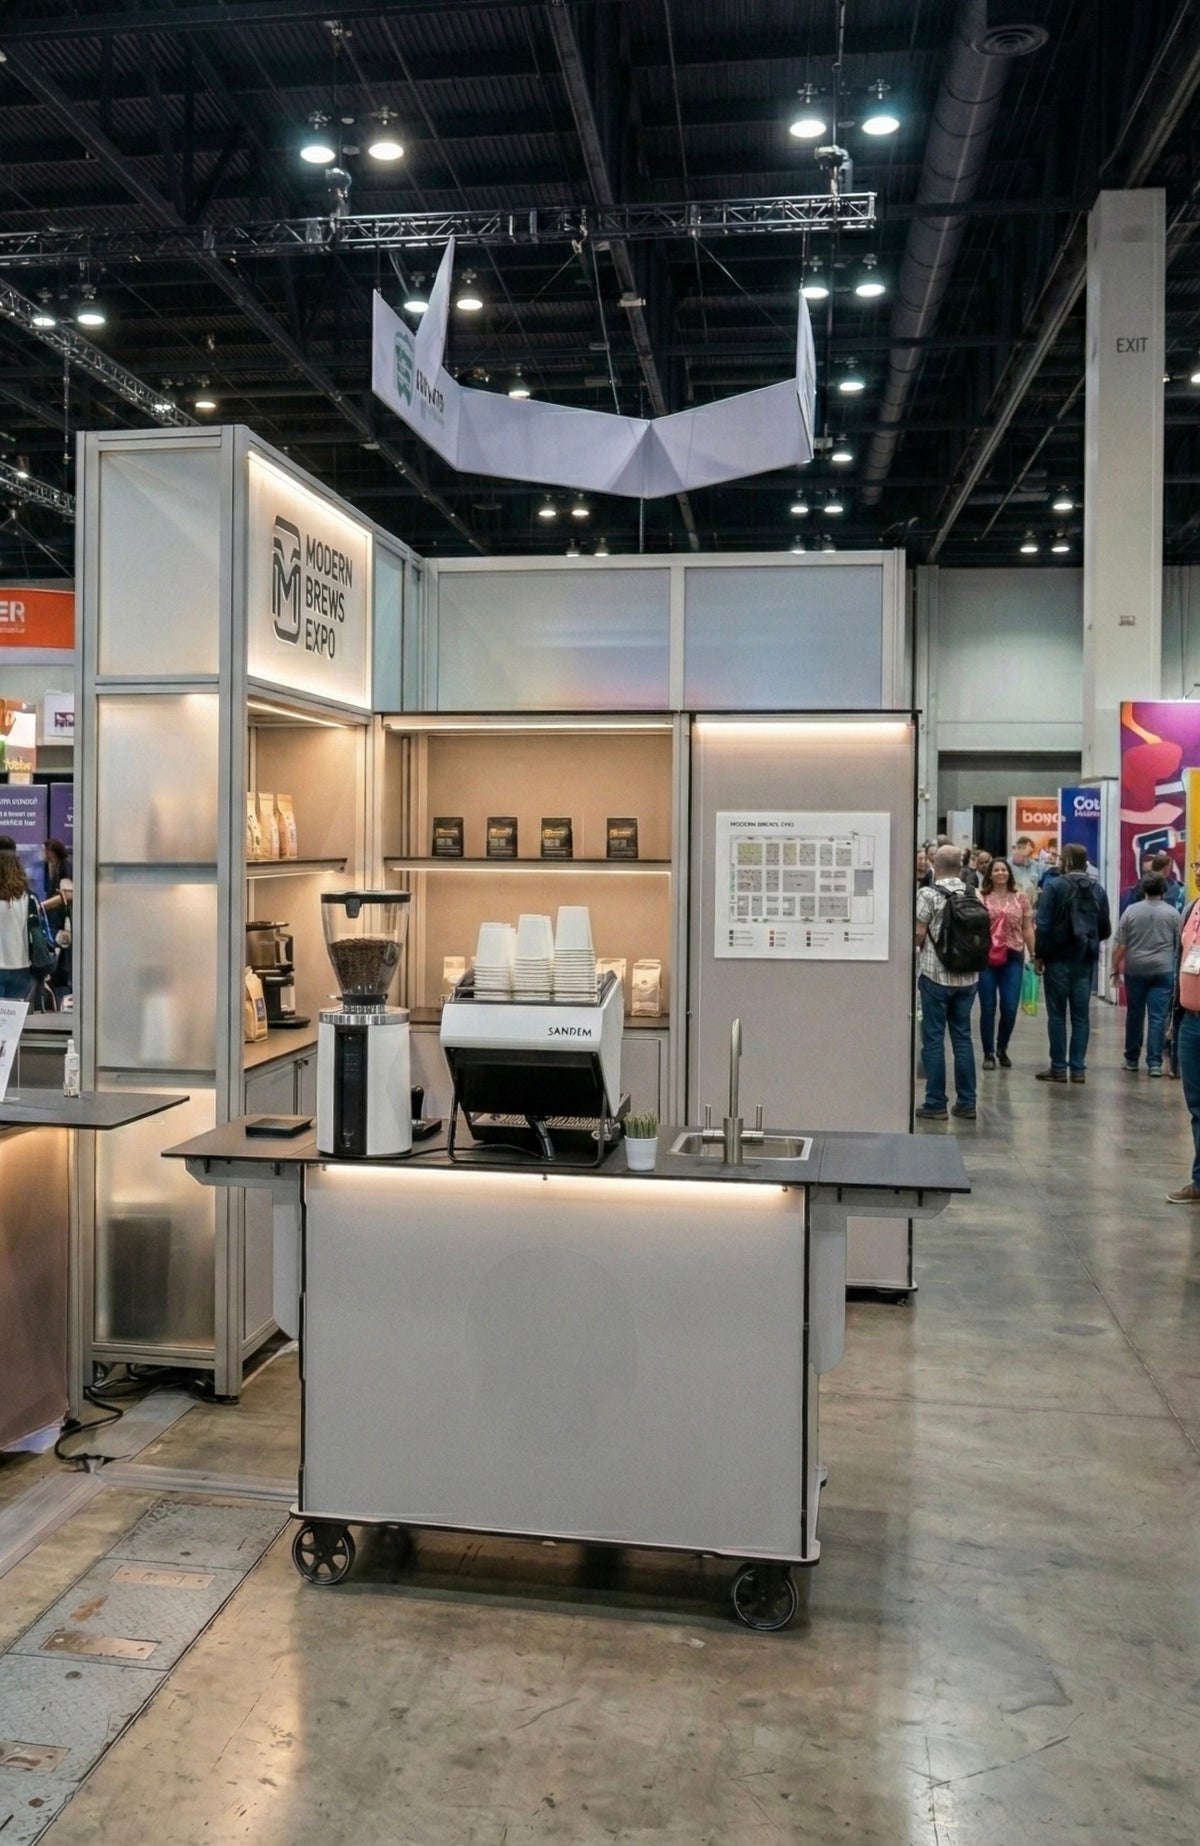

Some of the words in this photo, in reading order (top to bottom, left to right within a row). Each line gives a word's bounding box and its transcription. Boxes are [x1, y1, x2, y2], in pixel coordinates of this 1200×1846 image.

[1116, 336, 1149, 353] EXIT
[306, 534, 353, 588] MODERN
[305, 575, 345, 623] BREWS
[305, 618, 335, 660] EXPO
[547, 1026, 592, 1037] SANDEM
